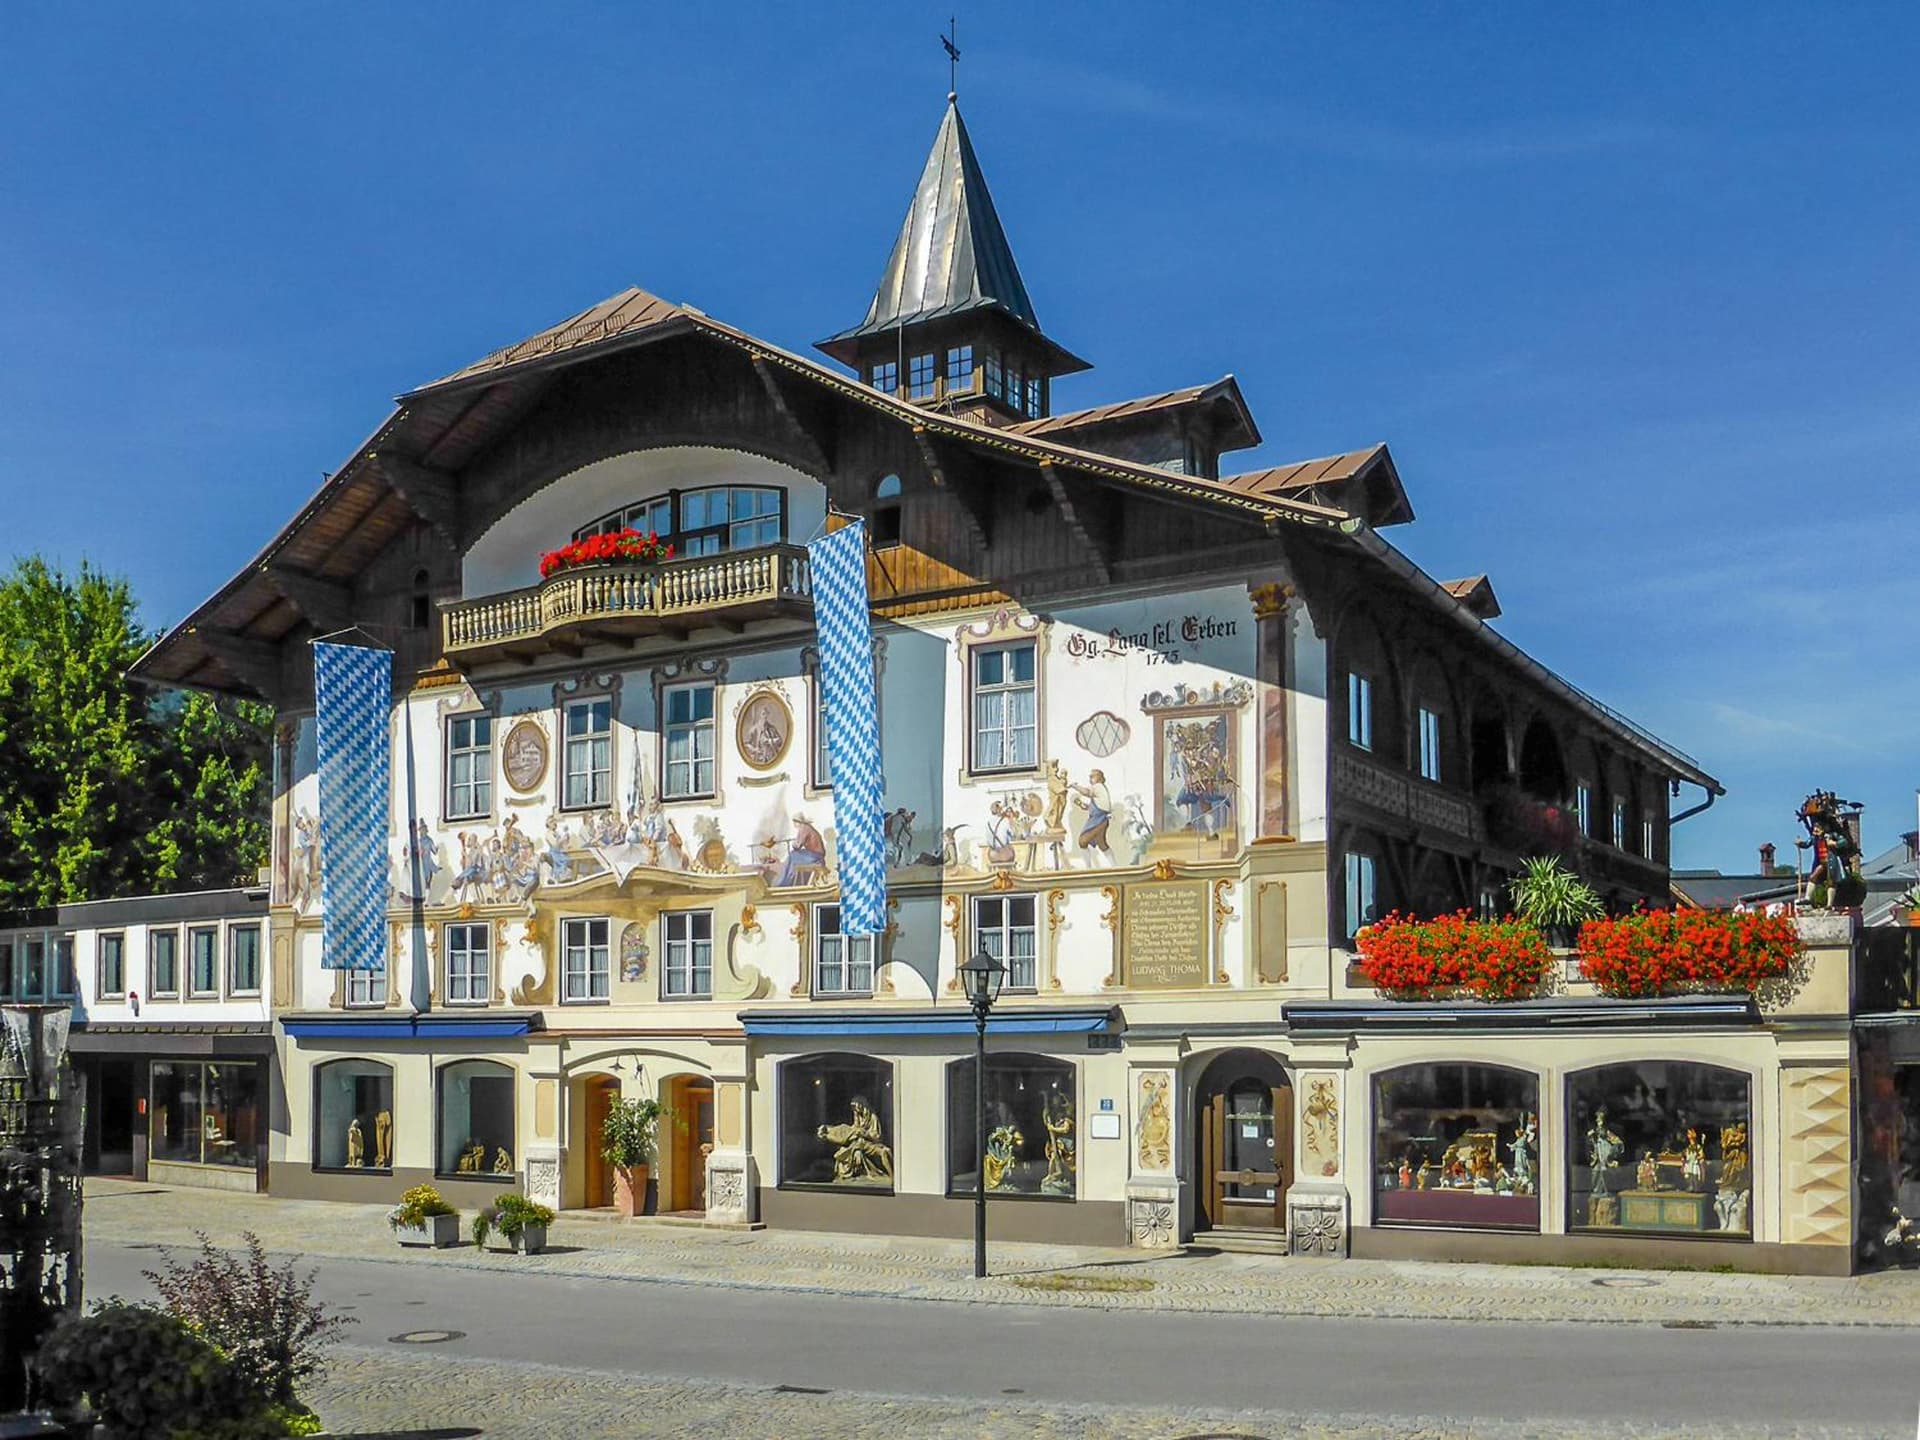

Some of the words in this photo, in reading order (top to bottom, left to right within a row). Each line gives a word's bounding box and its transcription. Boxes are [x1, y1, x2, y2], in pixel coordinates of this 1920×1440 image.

[1102, 627, 1148, 656] Lang
[1181, 615, 1237, 642] Erben
[1132, 965, 1166, 976] LUDWIG
[1170, 964, 1200, 974] THOMA
